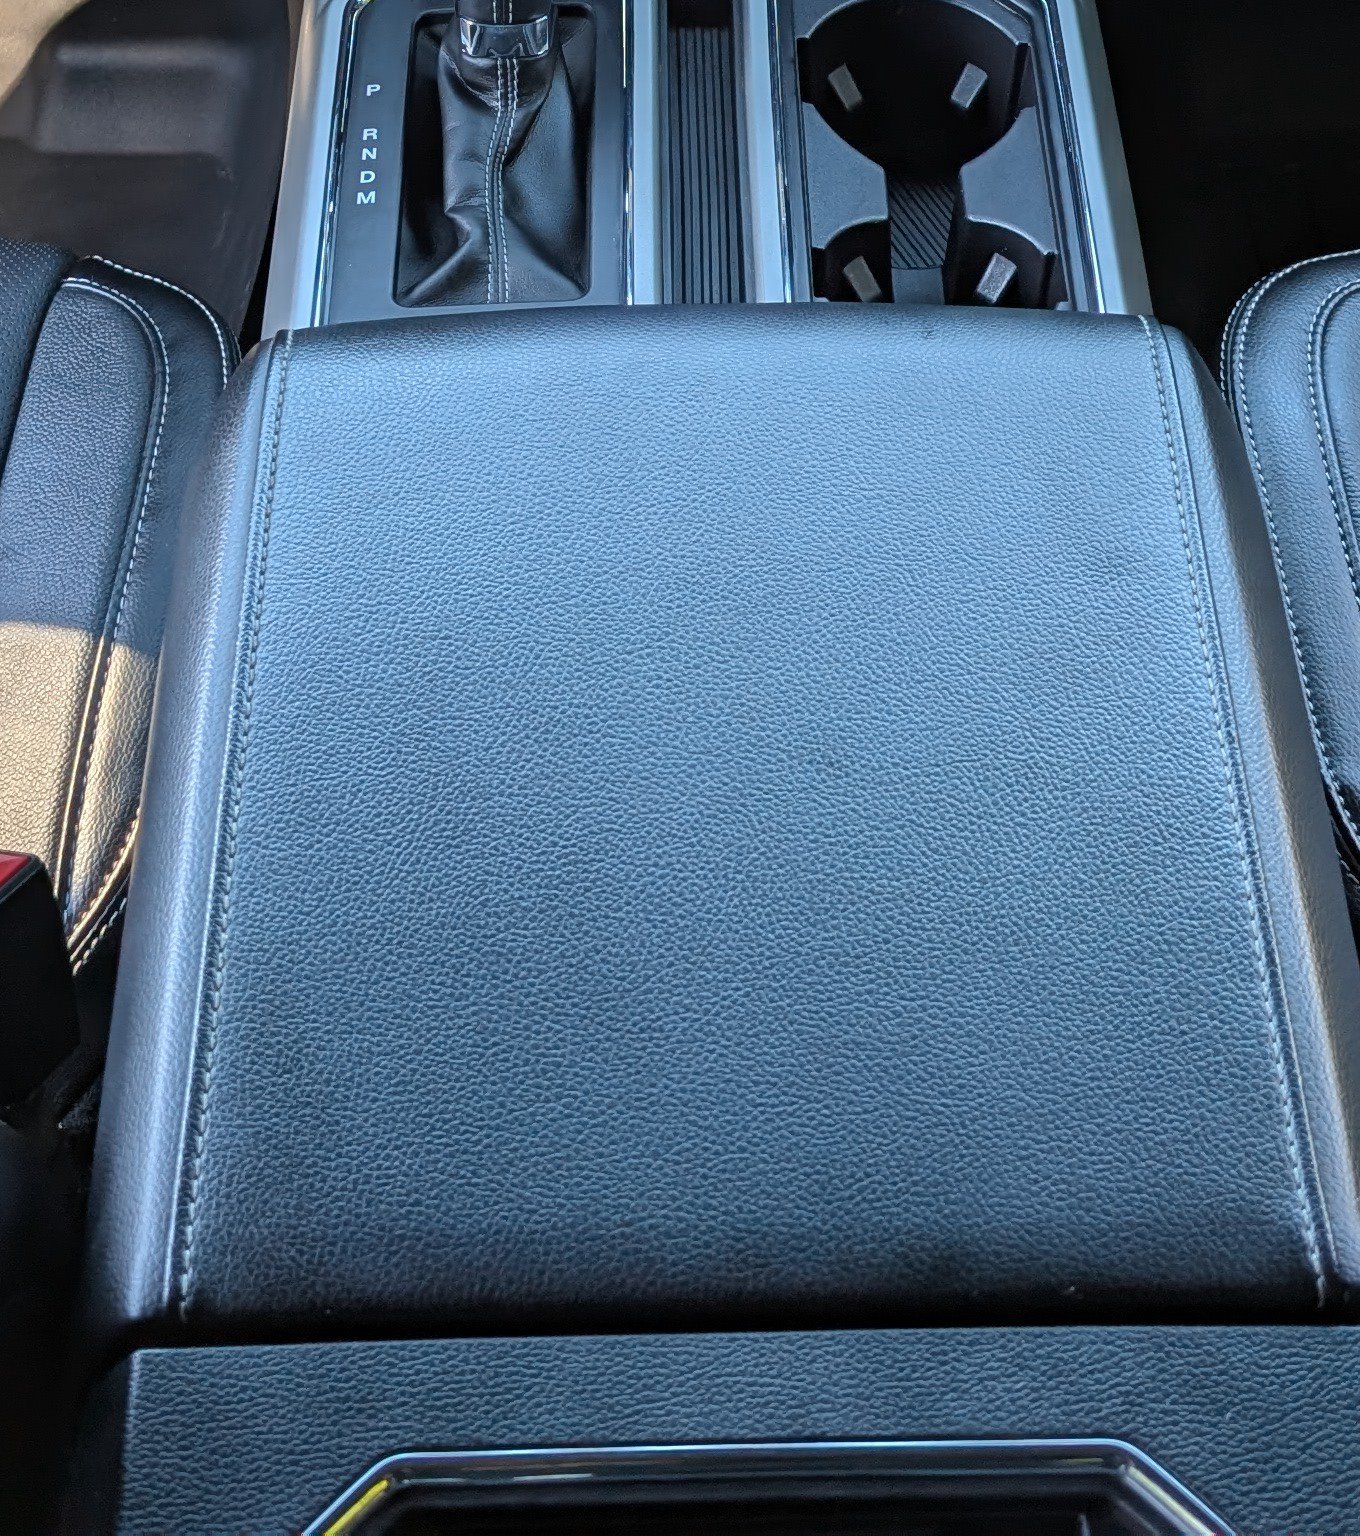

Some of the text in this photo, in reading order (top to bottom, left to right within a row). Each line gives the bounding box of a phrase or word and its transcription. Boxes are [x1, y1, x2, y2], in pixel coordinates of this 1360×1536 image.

[366, 84, 381, 96] P
[362, 128, 378, 141] R
[361, 148, 377, 161] N
[359, 170, 376, 184] D
[356, 190, 376, 205] M
